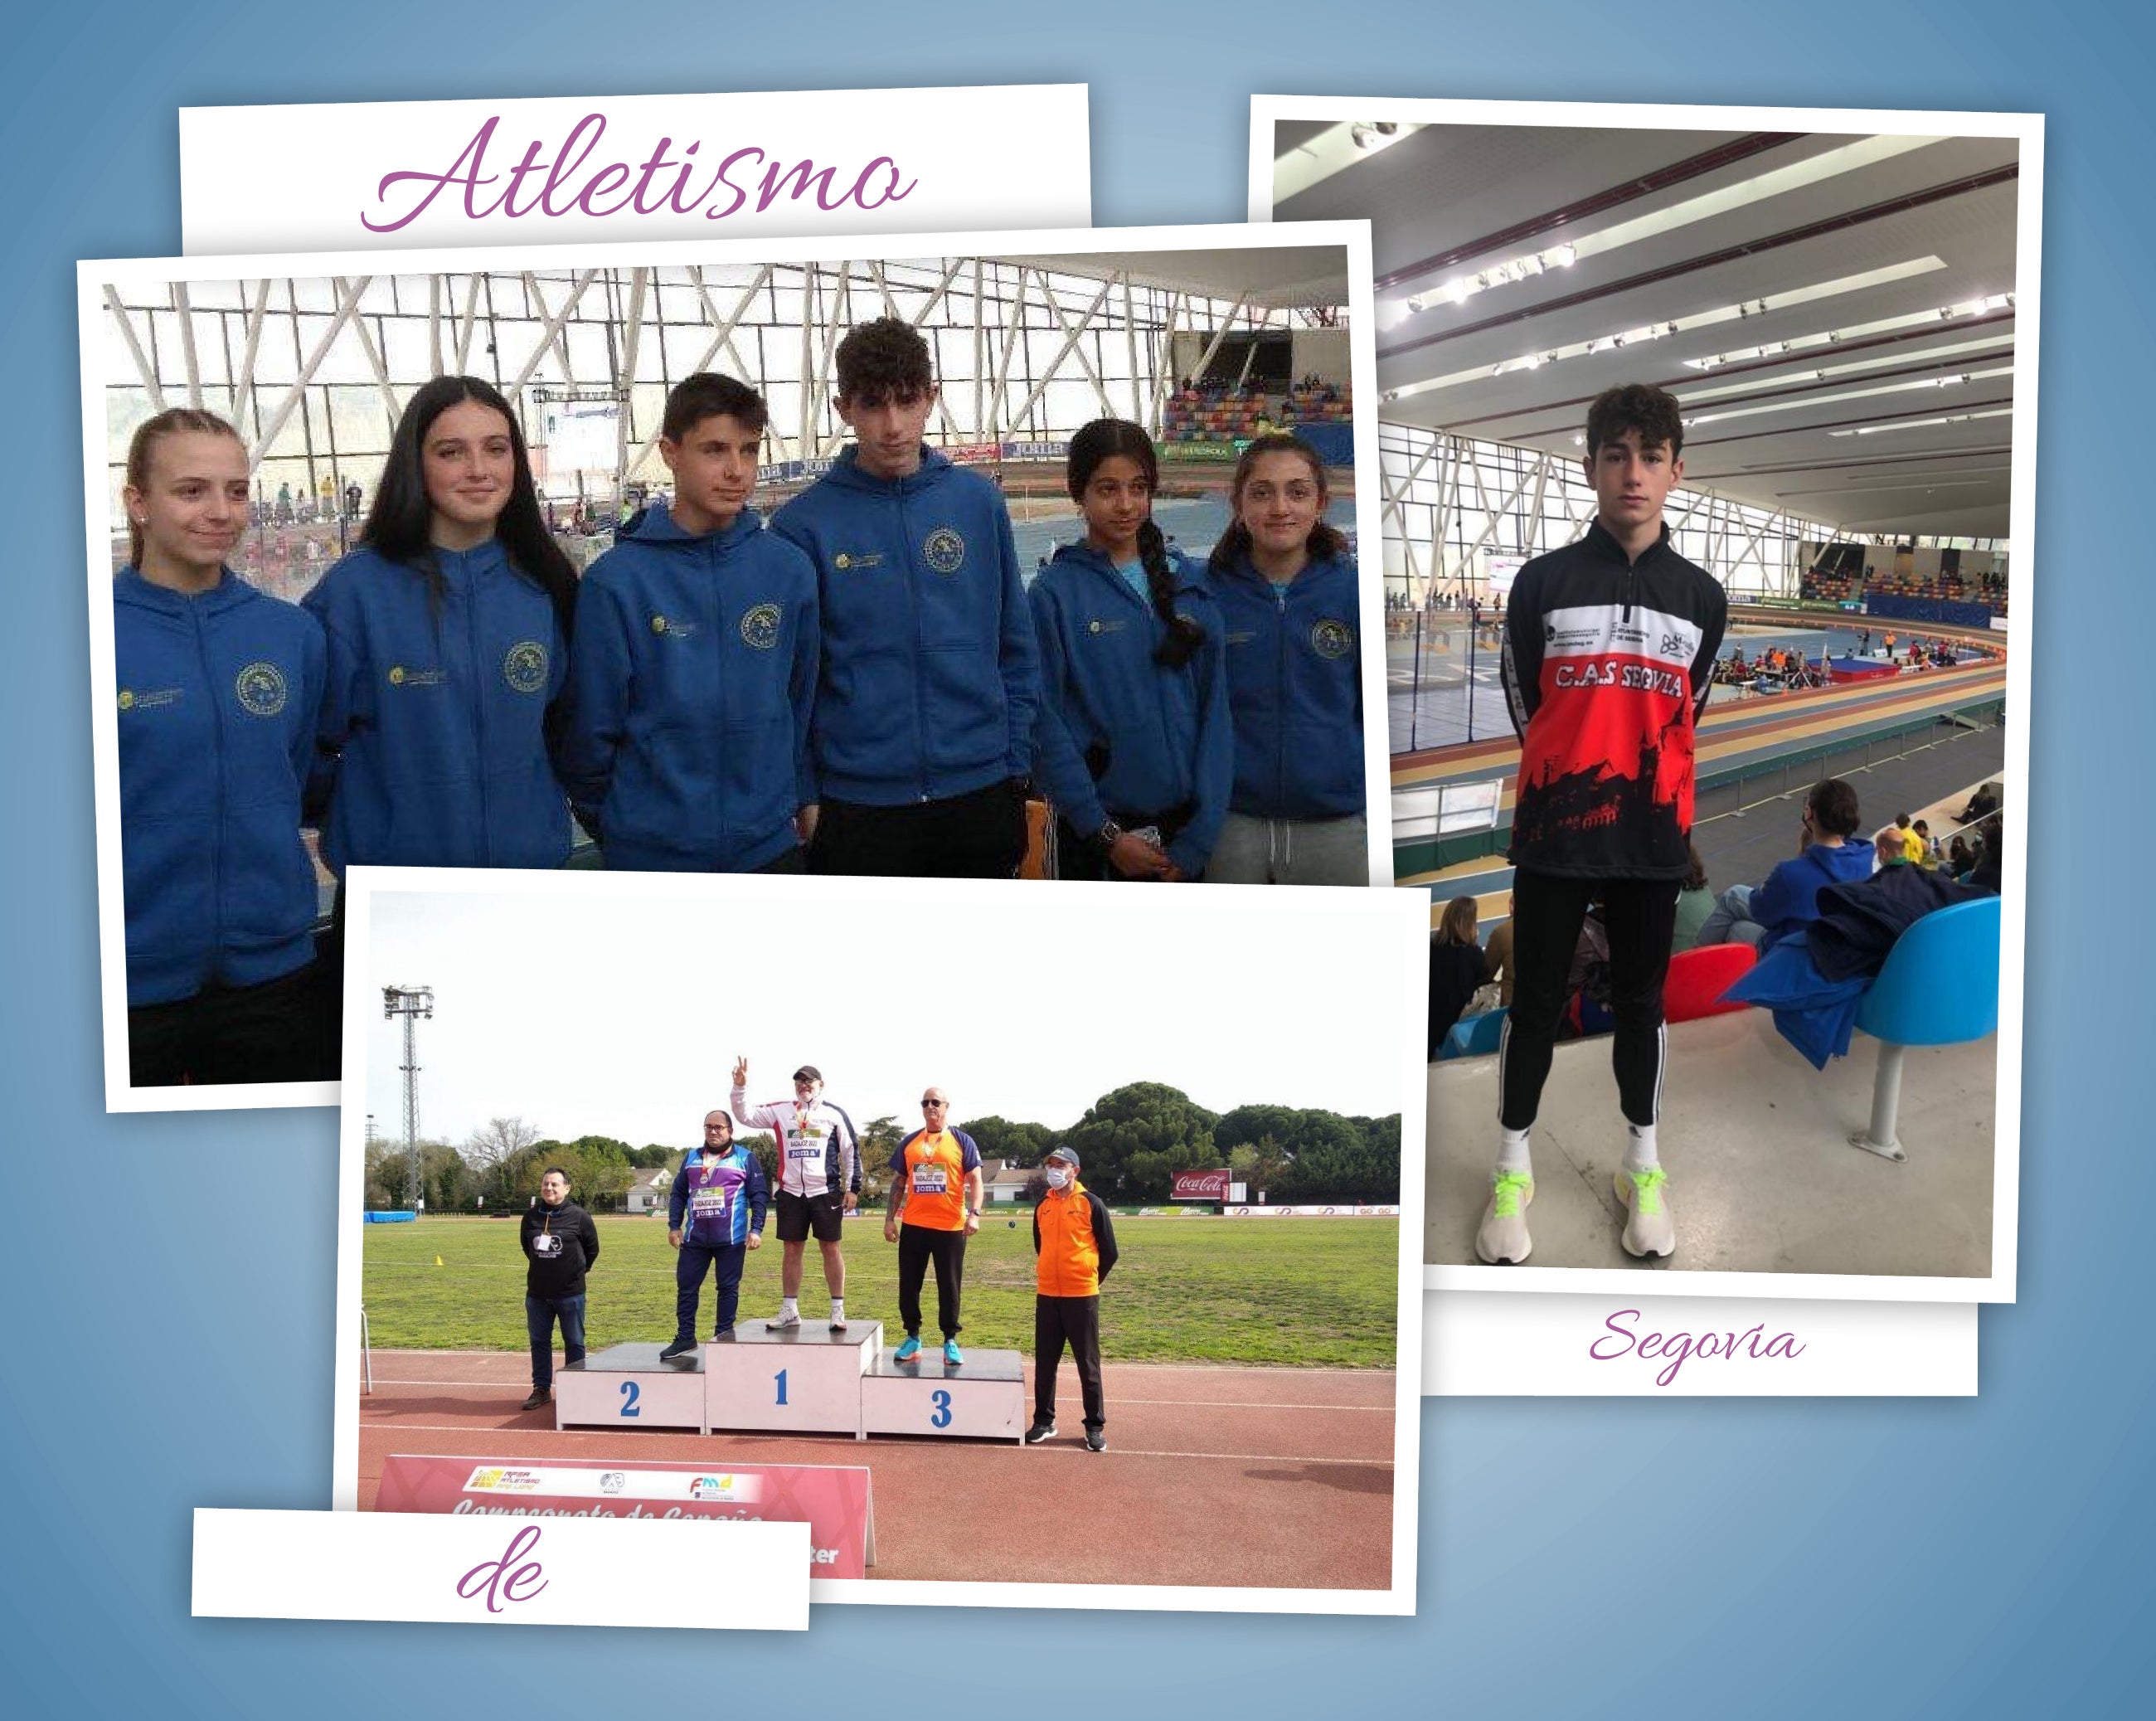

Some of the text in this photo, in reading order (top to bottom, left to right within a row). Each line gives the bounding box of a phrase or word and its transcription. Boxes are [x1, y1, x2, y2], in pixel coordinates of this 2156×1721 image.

[620, 1381, 641, 1417] 2
[774, 1369, 788, 1405] 1
[930, 1389, 952, 1428] 3
